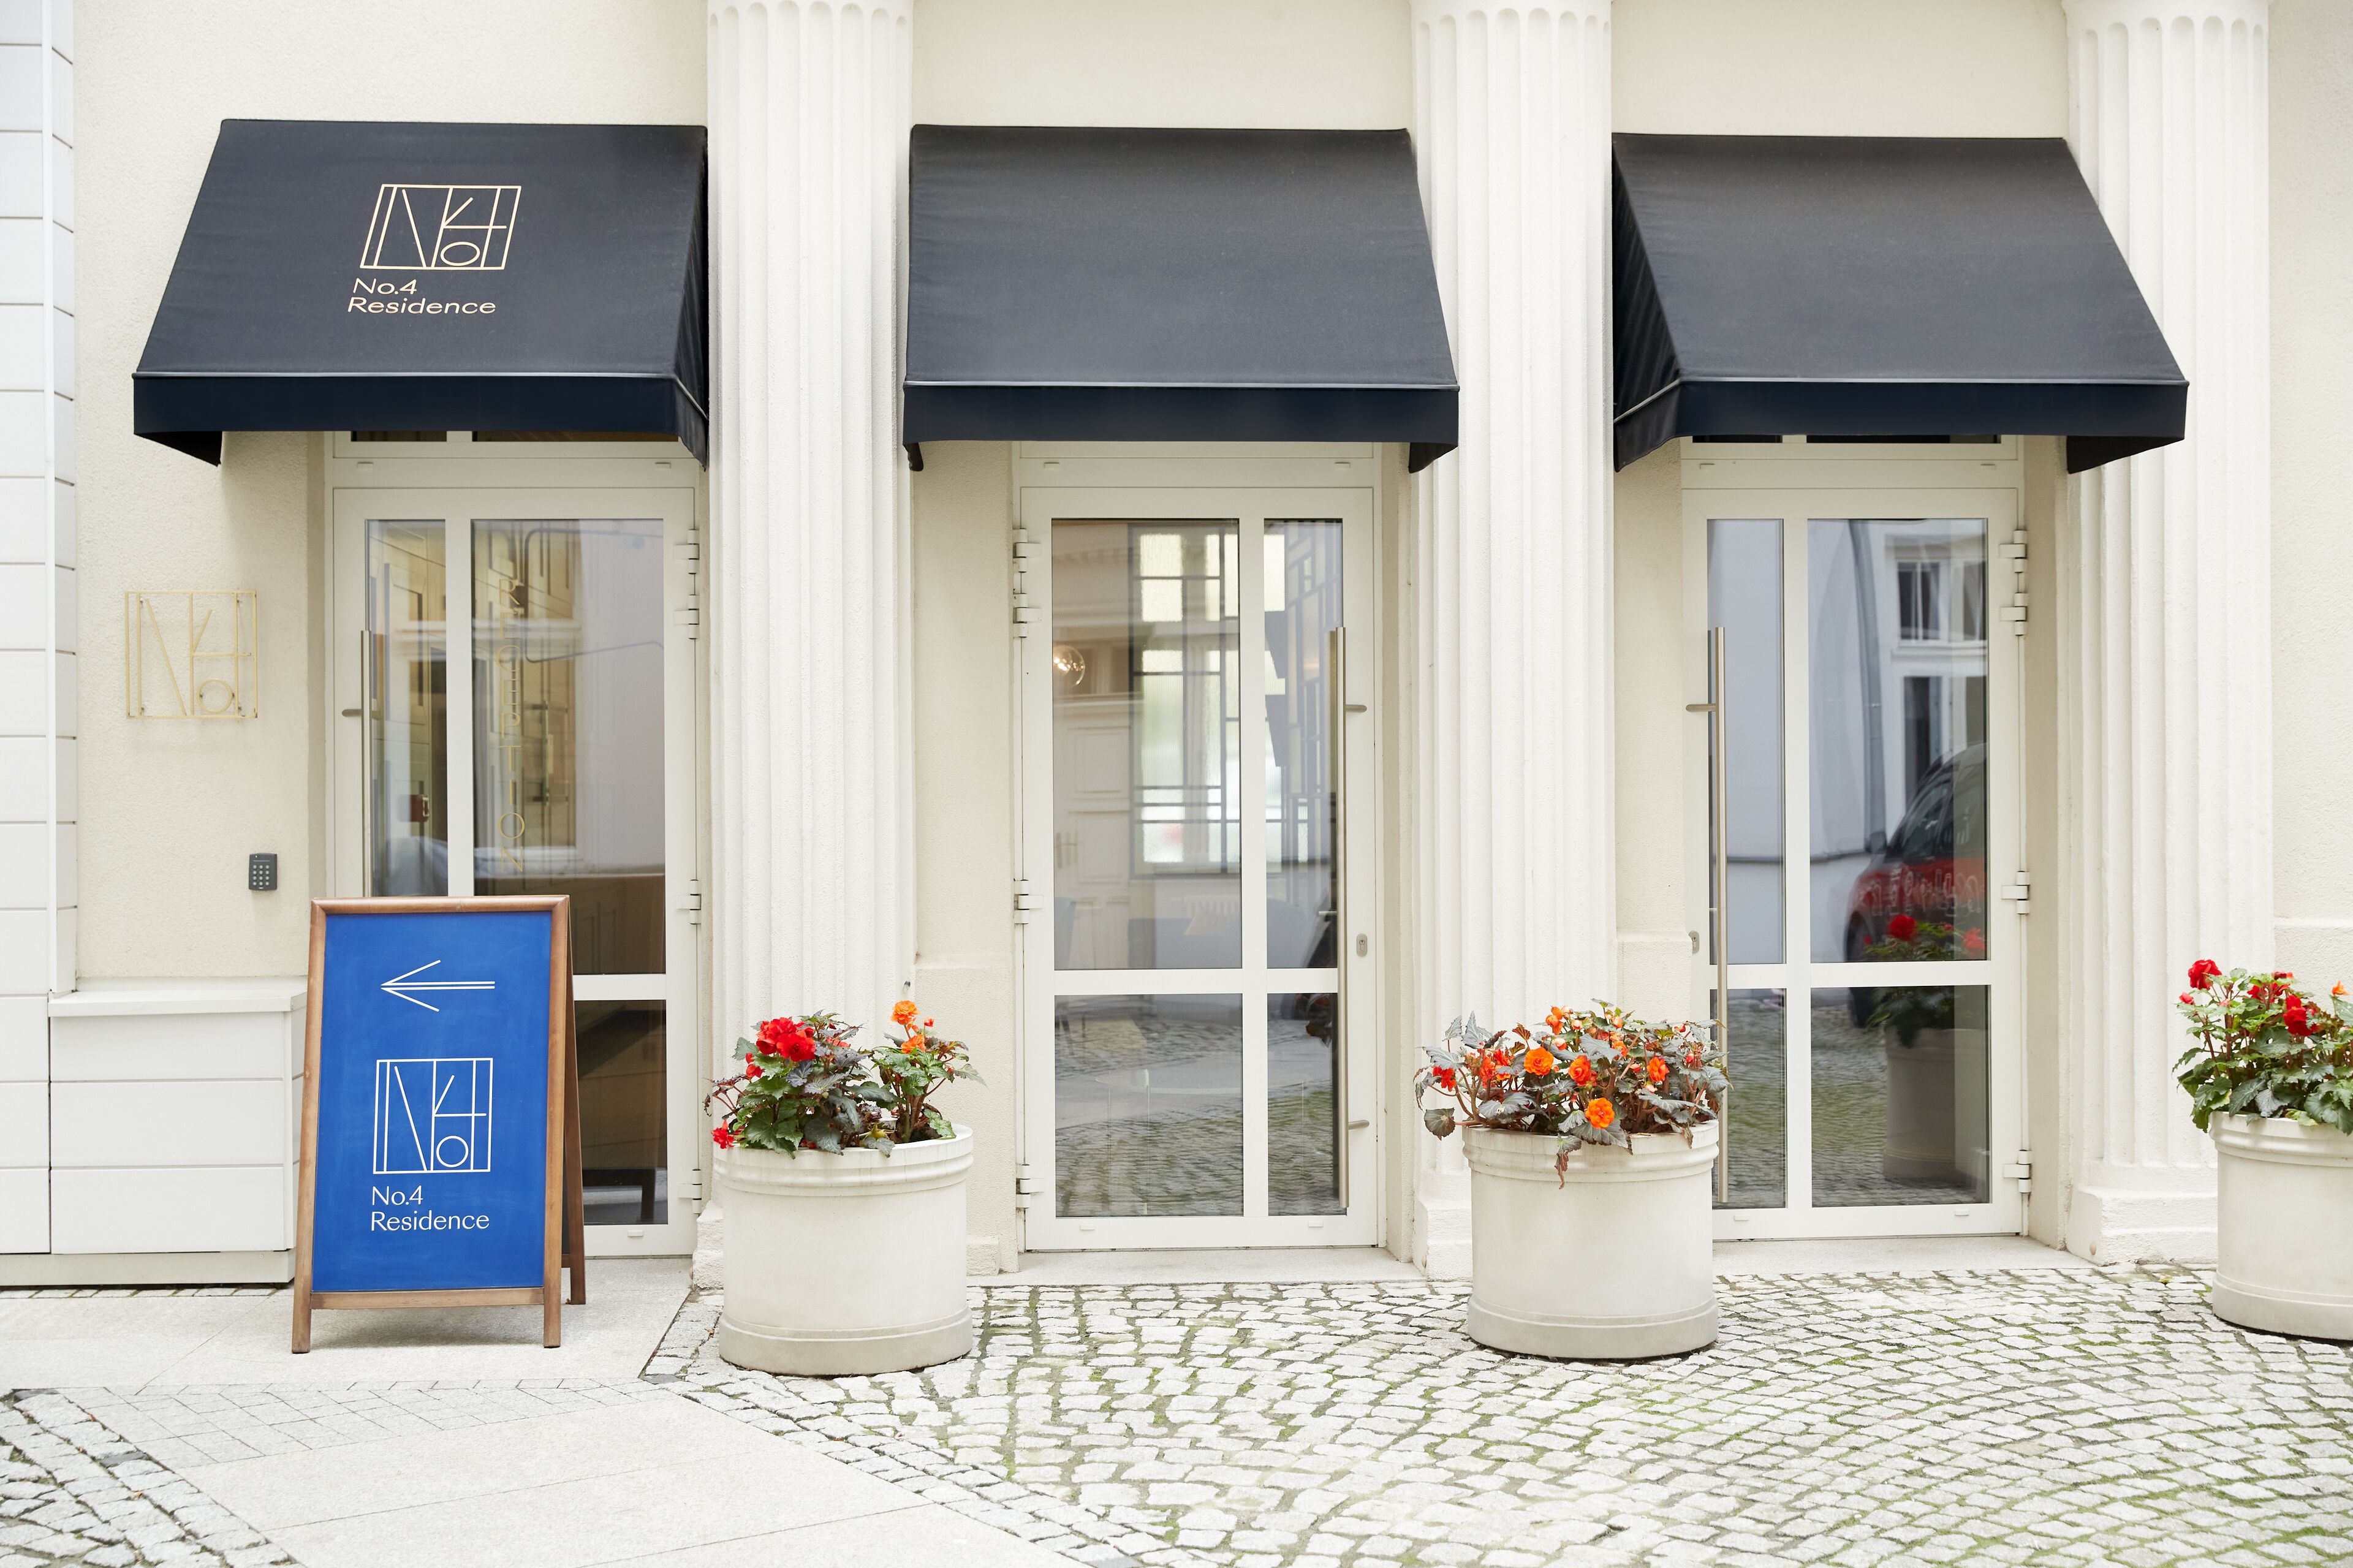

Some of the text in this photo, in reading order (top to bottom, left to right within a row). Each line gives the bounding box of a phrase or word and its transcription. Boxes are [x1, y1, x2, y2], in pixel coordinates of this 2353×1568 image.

[353, 277, 417, 295] No.4
[348, 297, 496, 315] Residence
[496, 578, 526, 873] RECEPTION
[372, 1185, 423, 1206] No.4
[371, 1210, 490, 1231] Residence
